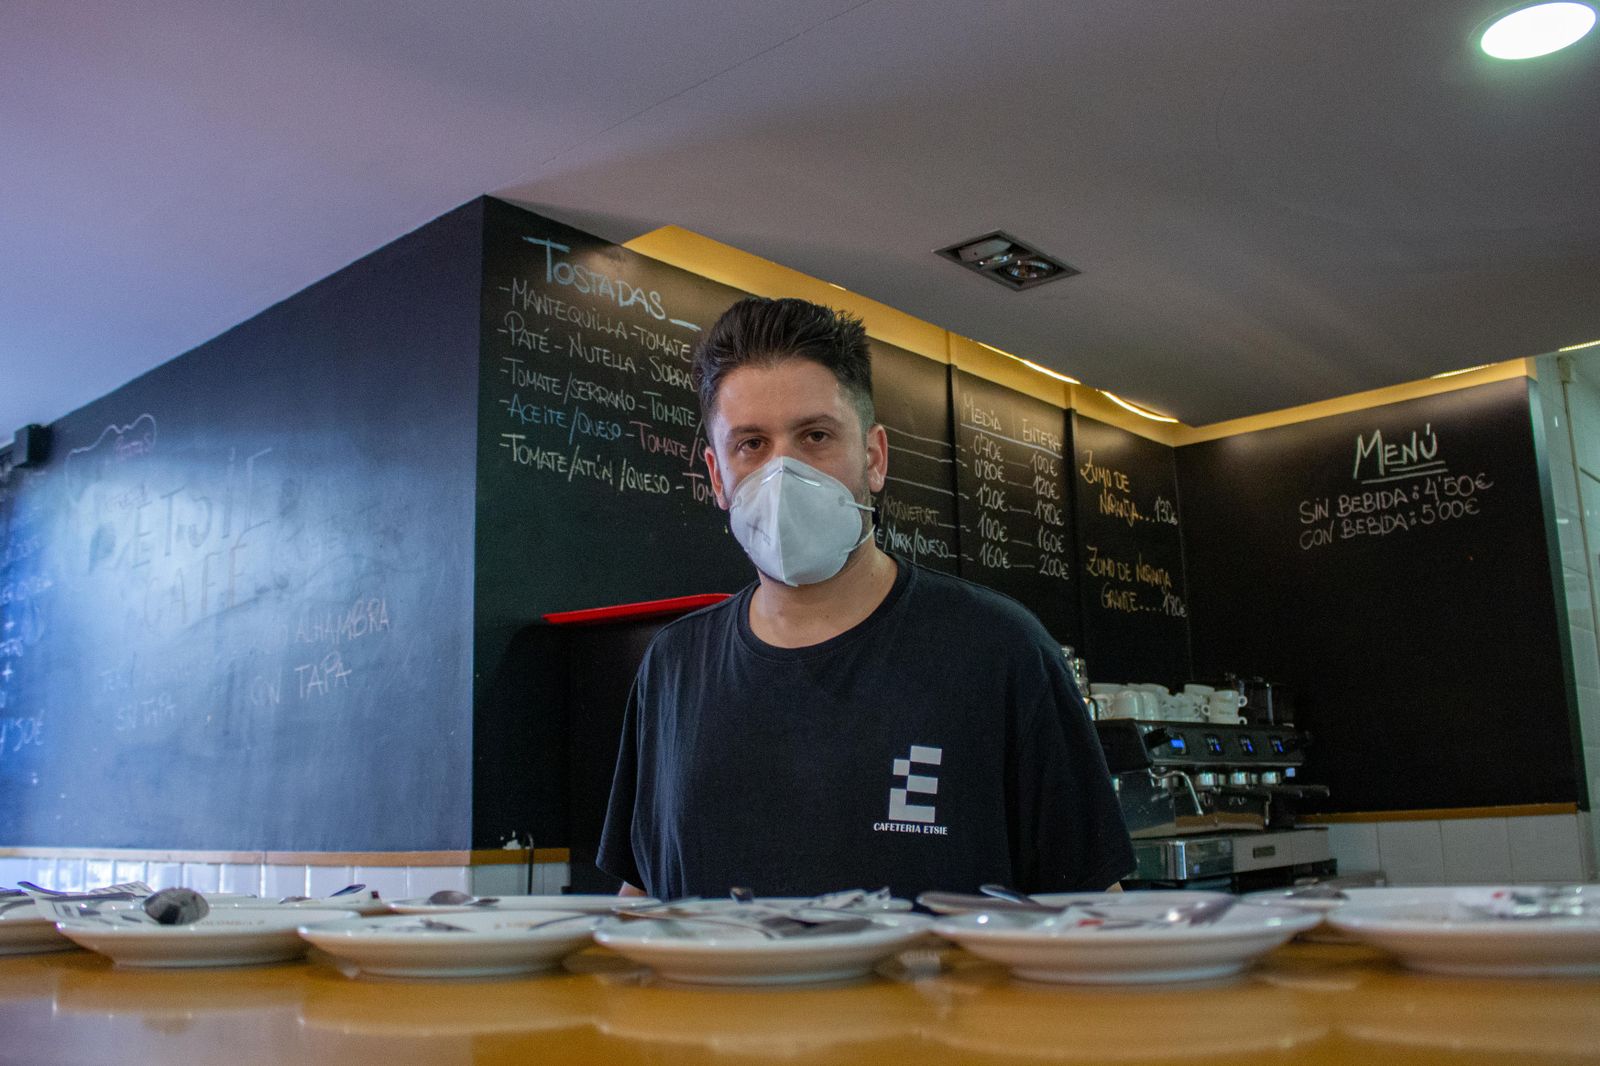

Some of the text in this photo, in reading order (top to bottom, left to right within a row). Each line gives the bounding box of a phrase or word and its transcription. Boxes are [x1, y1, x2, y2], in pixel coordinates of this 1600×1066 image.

[522, 237, 666, 320] TOSTADAS
[962, 393, 1063, 452] MEDIA ENTERA
[1080, 450, 1131, 493] ZUMO DE
[1352, 423, 1438, 480] MENÚ
[1299, 497, 1330, 524] SIN
[1299, 520, 1335, 550] CON
[1086, 545, 1115, 578] ZUMO
[1117, 561, 1132, 582] DE
[294, 650, 352, 702] TAPA
[873, 823, 948, 835] CAFETERIA ETSIE
